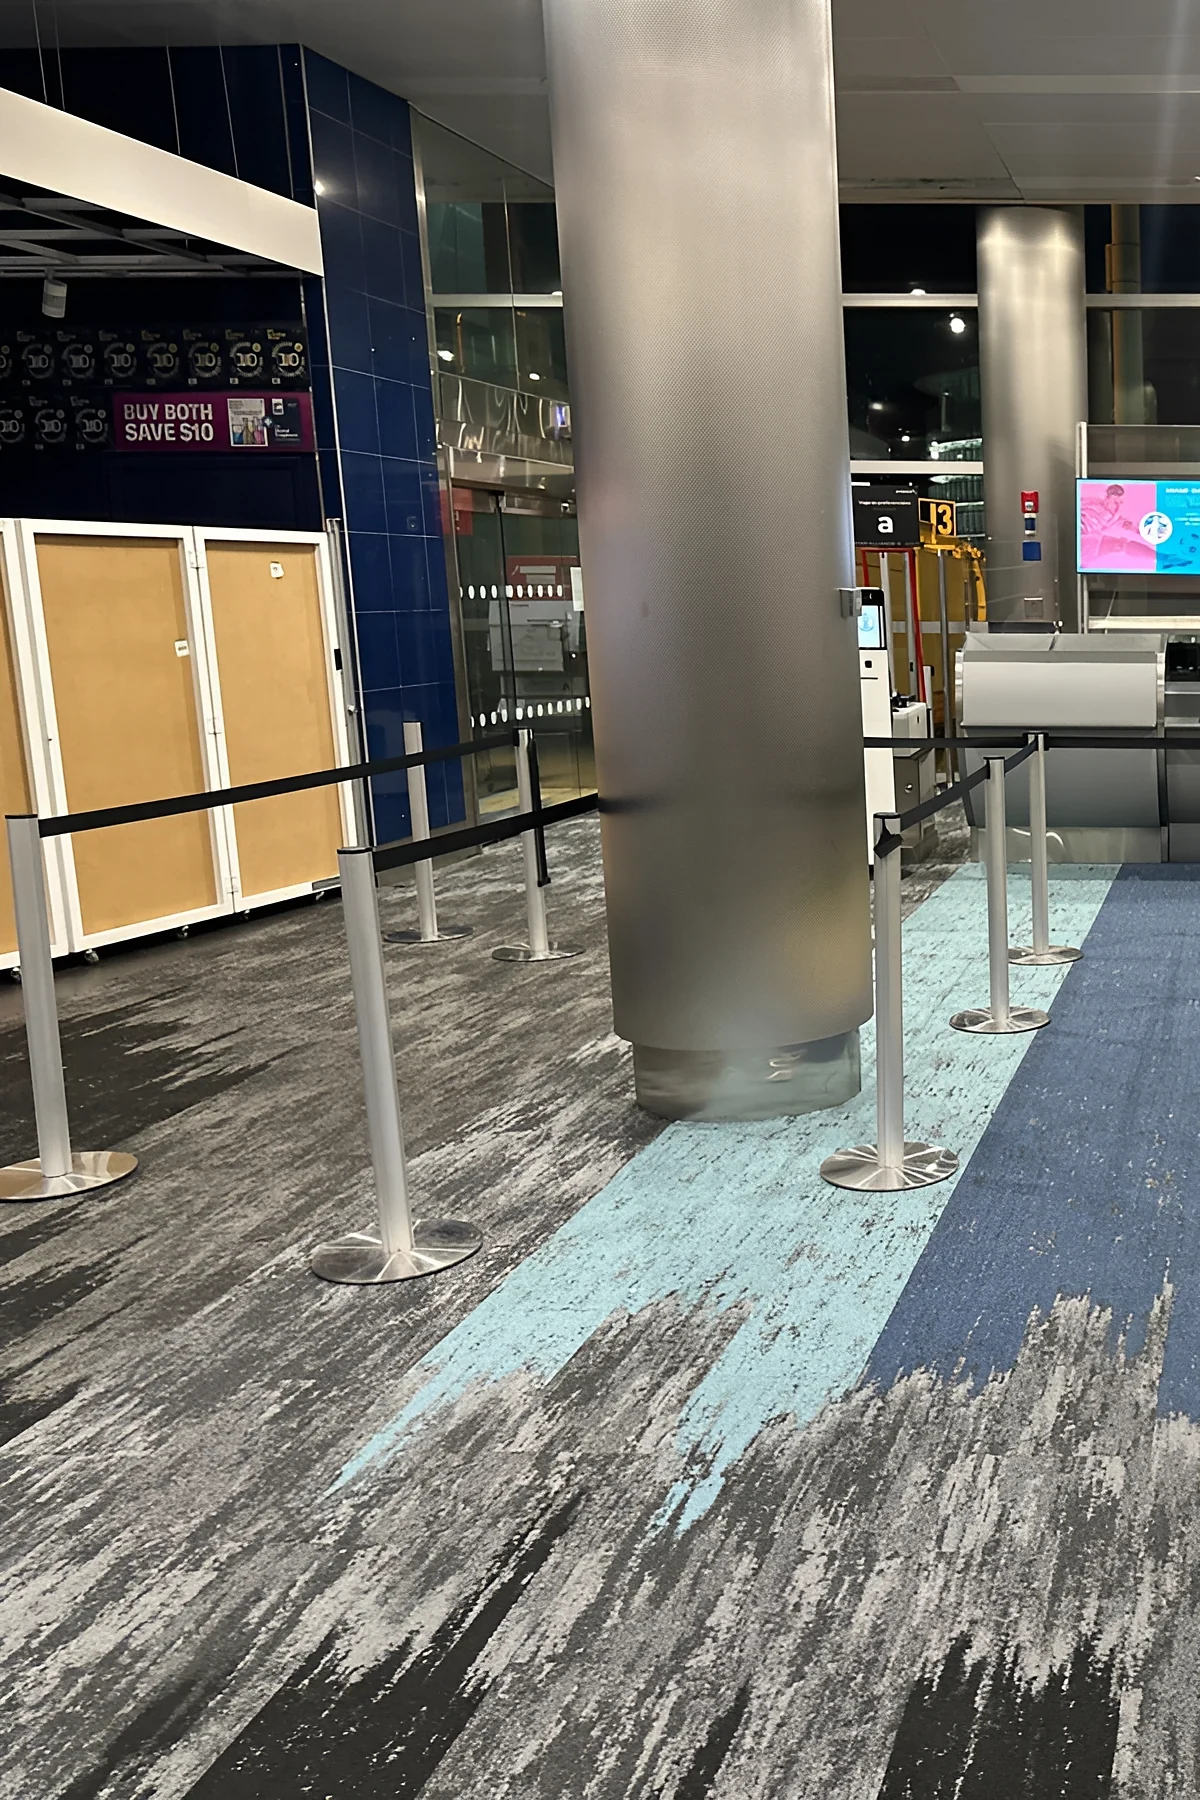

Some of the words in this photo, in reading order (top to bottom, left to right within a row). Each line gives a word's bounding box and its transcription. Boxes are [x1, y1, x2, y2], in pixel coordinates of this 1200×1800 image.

[279, 353, 301, 367] 10
[124, 403, 159, 421] BUY
[164, 403, 214, 421] BOTH
[125, 423, 177, 442] SAVE
[180, 423, 215, 443] $10
[877, 515, 894, 534] a
[929, 503, 954, 536] 13
